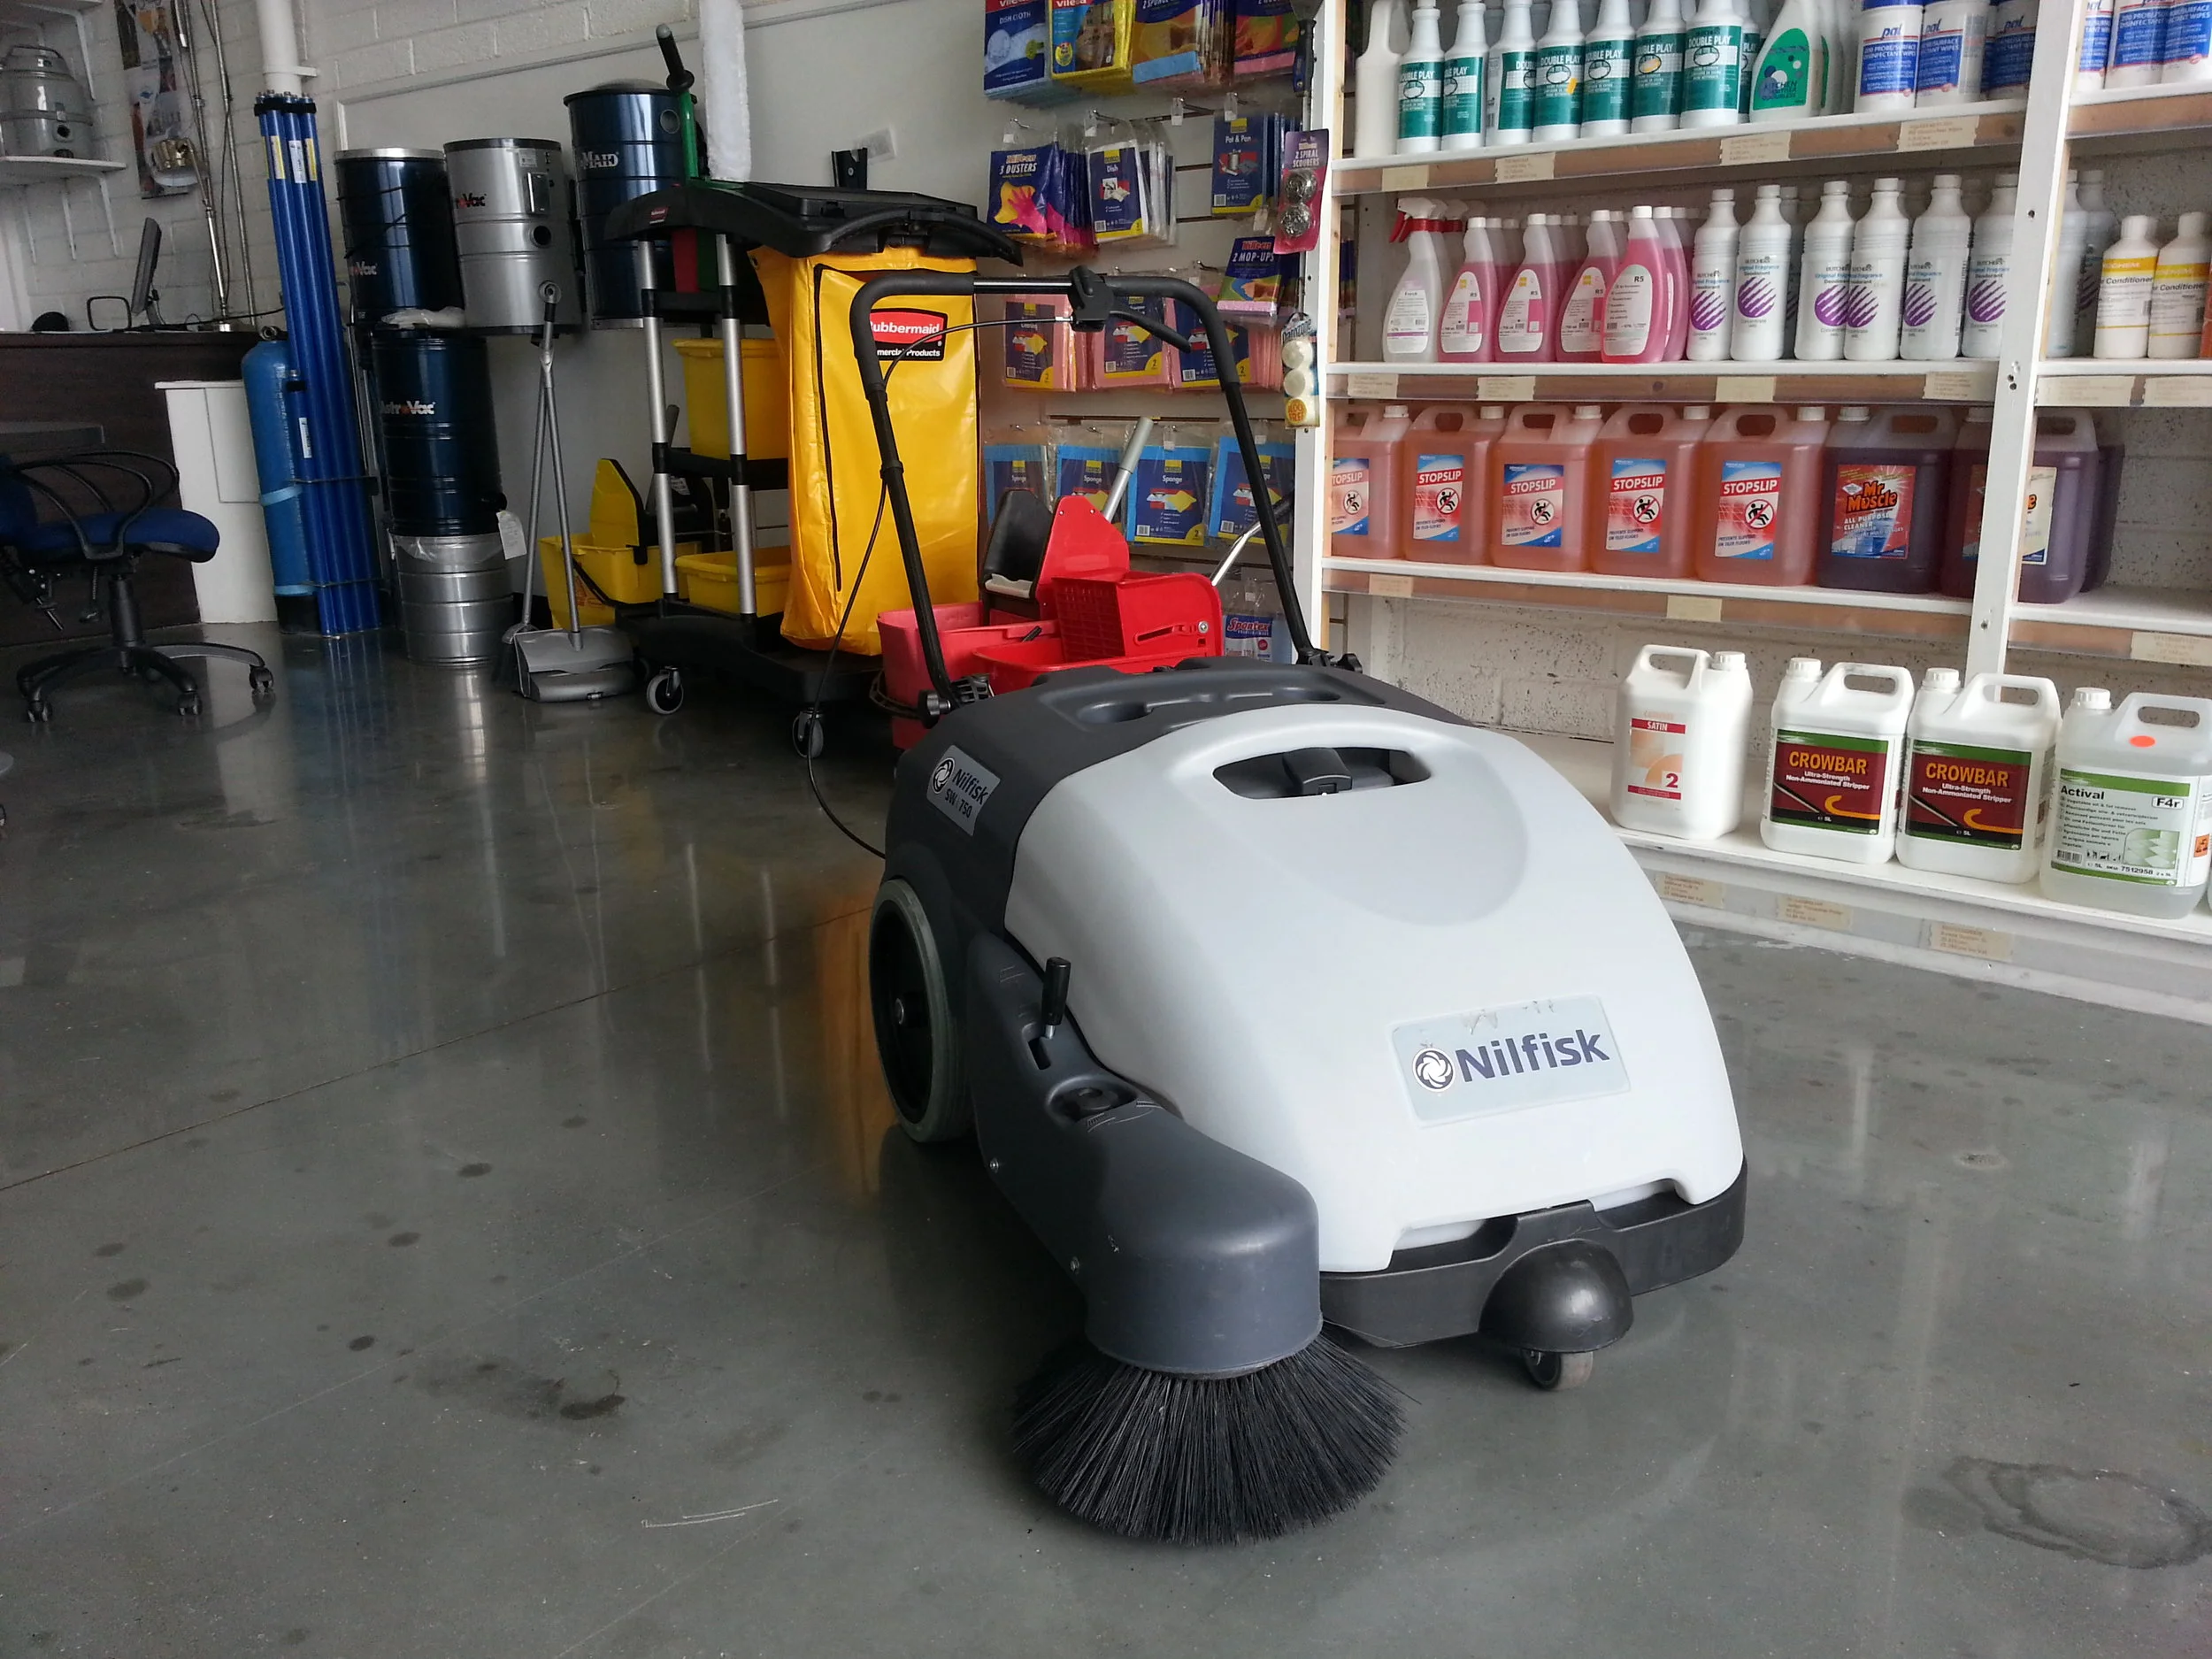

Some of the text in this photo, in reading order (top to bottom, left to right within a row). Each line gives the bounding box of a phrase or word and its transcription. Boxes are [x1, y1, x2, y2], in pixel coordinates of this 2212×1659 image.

[1880, 23, 1902, 41] pal
[1688, 35, 1731, 48] DOUBLE PLAY
[1656, 43, 1673, 53] PLAY
[1540, 55, 1581, 66] DOUBLE PLAY
[1605, 50, 1622, 59] PLAY
[1516, 60, 1536, 70] DOUB
[1418, 70, 1434, 80] PLAY
[1453, 67, 1467, 76] PLAY
[1300, 150, 1318, 159] SPIRAL
[999, 162, 1038, 175] 3 DUSTERS
[1107, 164, 1119, 173] Dish
[1233, 251, 1274, 263] 2 MOP-UPS
[2106, 275, 2154, 285] Conditioner
[876, 348, 905, 357] mercia
[1240, 365, 1245, 374] 2
[1011, 474, 1027, 483] Sponge
[1083, 474, 1102, 484] Sponge
[1162, 474, 1183, 484] Sponge
[1418, 470, 1462, 484] STOPSLIP
[1510, 479, 1556, 495] STOPSLIP
[1613, 476, 1663, 491] STOPSLIP
[1723, 480, 1778, 495] STOPSLIP
[1863, 480, 1886, 497] Mr
[1846, 489, 1898, 513] Muscle
[1844, 512, 1890, 525] ALL PURPOSE
[1844, 520, 1873, 531] CLEANER
[1194, 529, 1199, 538] 2
[1227, 617, 1269, 632] Spontex
[1647, 721, 1668, 732] SATIN
[1789, 751, 1867, 775] CROWBAR
[1665, 772, 1678, 788] 2
[1804, 771, 1851, 782] Ultra-Strength
[1925, 763, 2009, 787] CROWBAR
[952, 768, 989, 805] Nilfisk
[1786, 774, 1870, 790] Non-Ammoniated Stripper
[1922, 787, 2012, 803] Non-Ammoniated Stripper
[1941, 783, 1992, 795] Ultra-Strength
[2061, 786, 2105, 800] Actival
[958, 799, 973, 818] 750
[2156, 797, 2181, 808] F4r
[1455, 1029, 1610, 1082] Nilfisk
